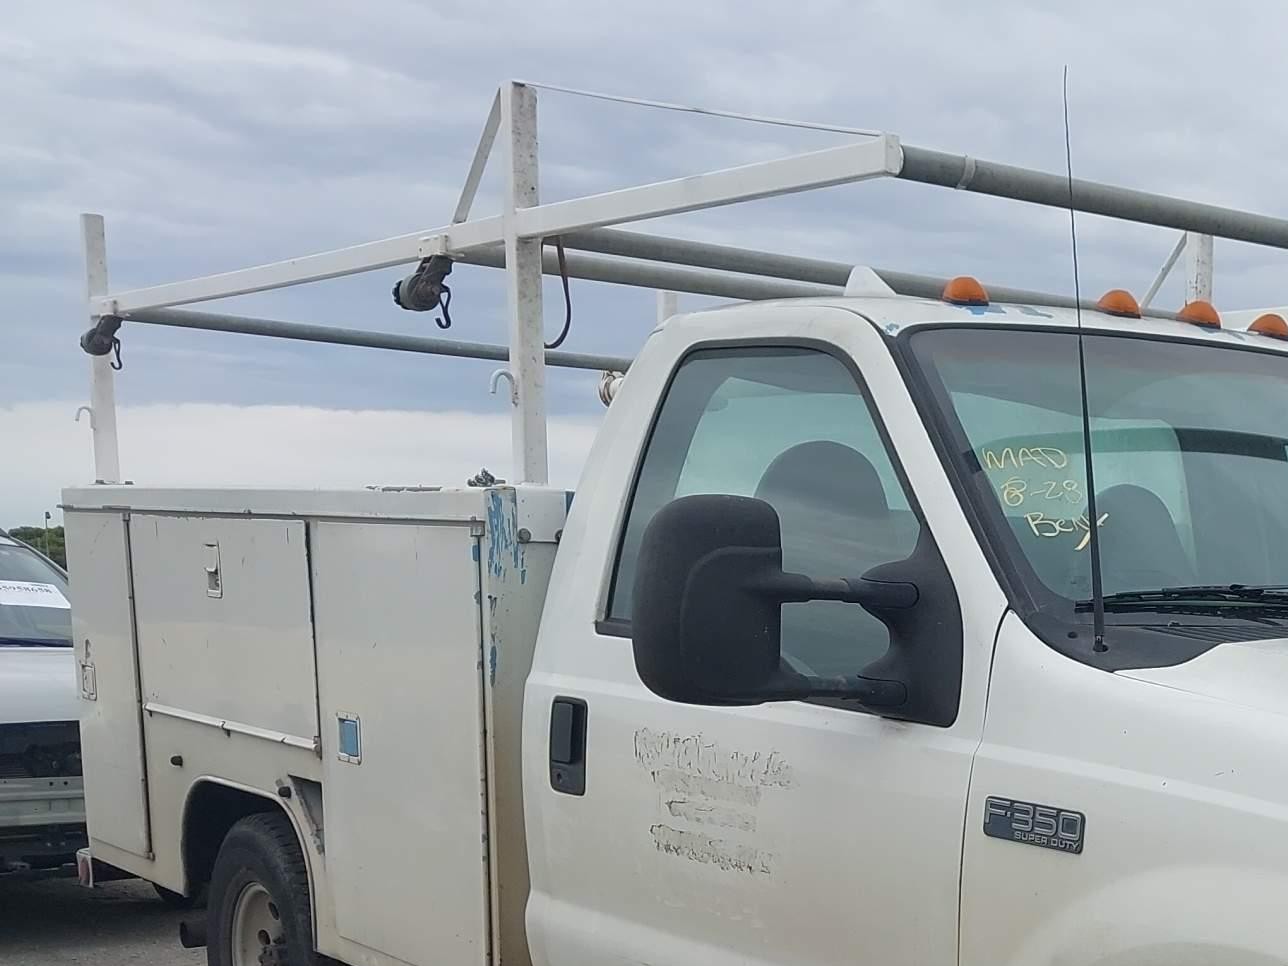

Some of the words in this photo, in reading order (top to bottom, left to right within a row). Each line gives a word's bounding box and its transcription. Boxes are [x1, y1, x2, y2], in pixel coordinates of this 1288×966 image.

[984, 799, 1081, 842] F-350
[1014, 831, 1048, 847] SUPER
[1050, 838, 1080, 851] DUTY
